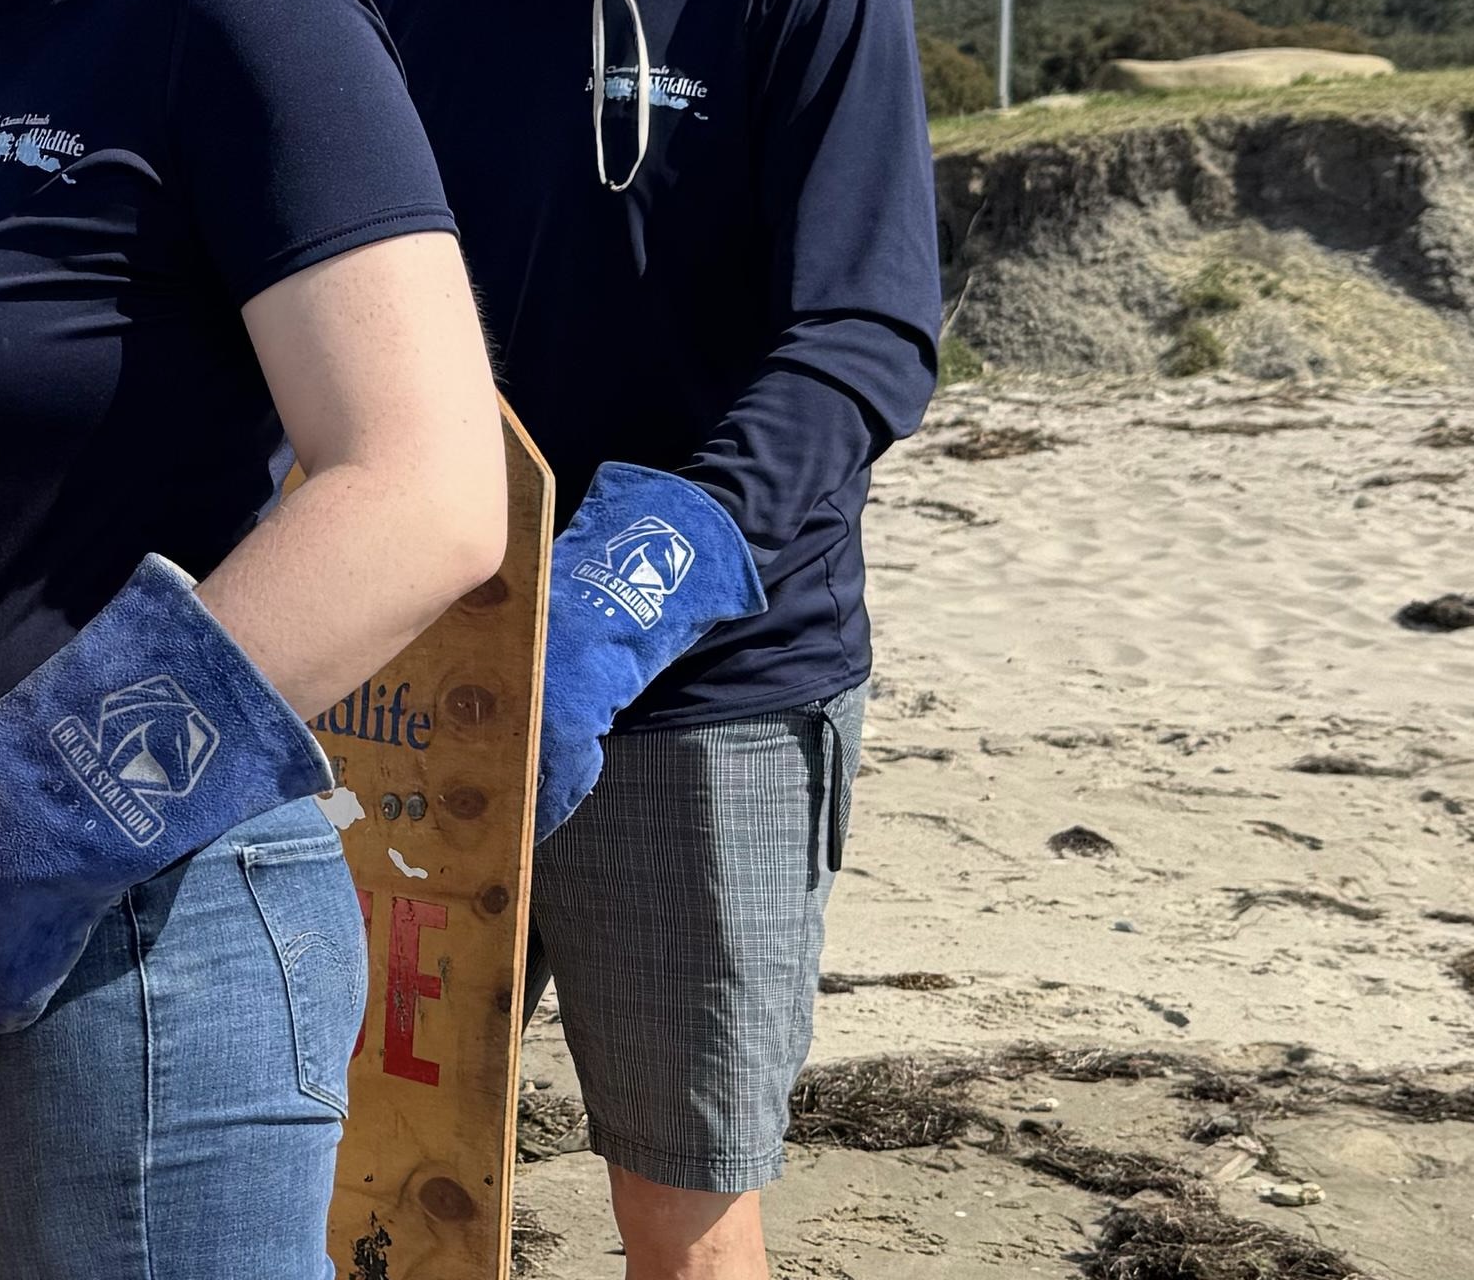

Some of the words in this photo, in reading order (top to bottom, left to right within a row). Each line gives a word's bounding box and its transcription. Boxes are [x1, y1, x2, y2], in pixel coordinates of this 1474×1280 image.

[608, 577, 655, 623] STALLION
[305, 679, 431, 750] dlife
[58, 726, 101, 777] BLACK
[91, 768, 154, 836] STALLION
